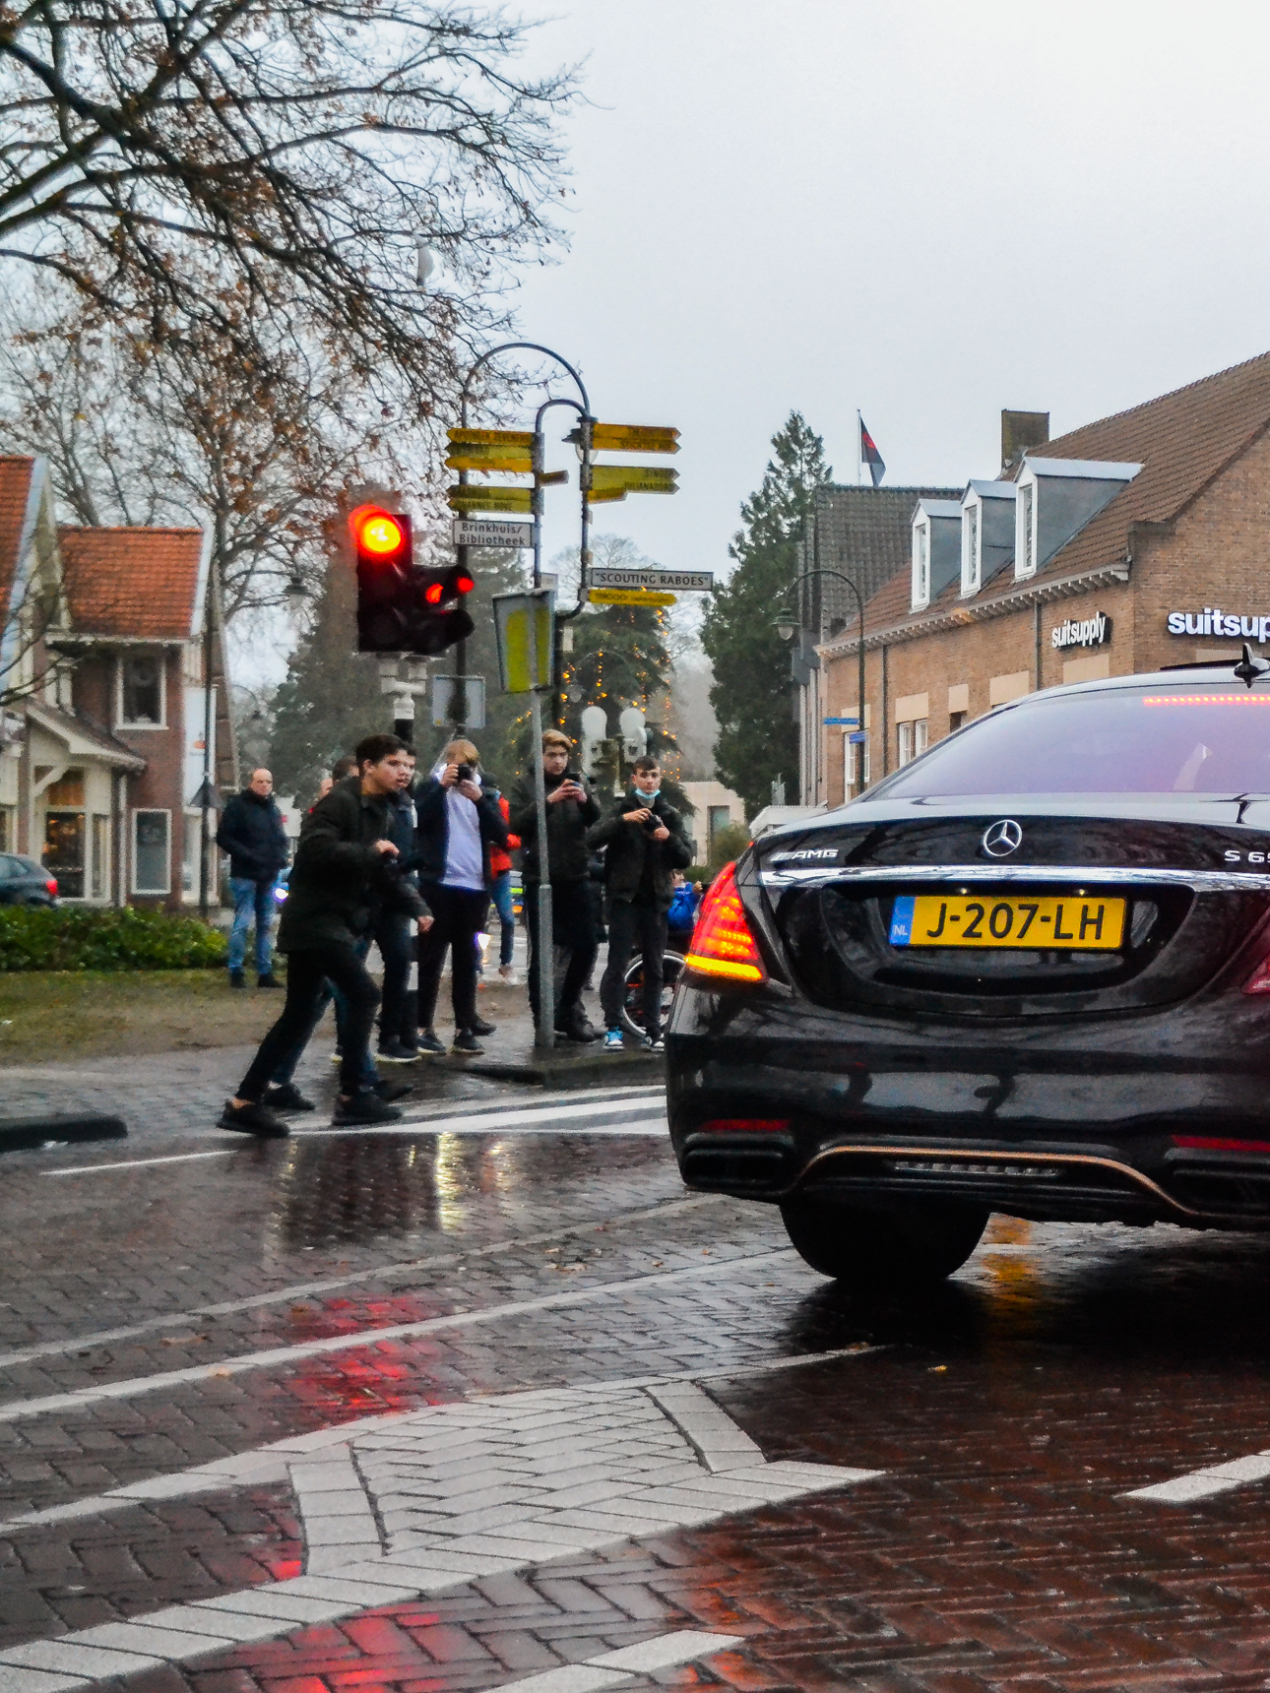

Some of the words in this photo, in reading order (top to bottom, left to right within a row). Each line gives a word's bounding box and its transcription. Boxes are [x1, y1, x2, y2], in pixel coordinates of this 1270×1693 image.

[462, 522, 523, 534] Brinkhuis/
[459, 533, 526, 546] Bibliotheek
[1051, 611, 1107, 648] suitsupply
[791, 848, 839, 860] AMG
[1224, 849, 1240, 862] S
[927, 902, 1105, 941] J-207-LH
[892, 924, 908, 936] NL
